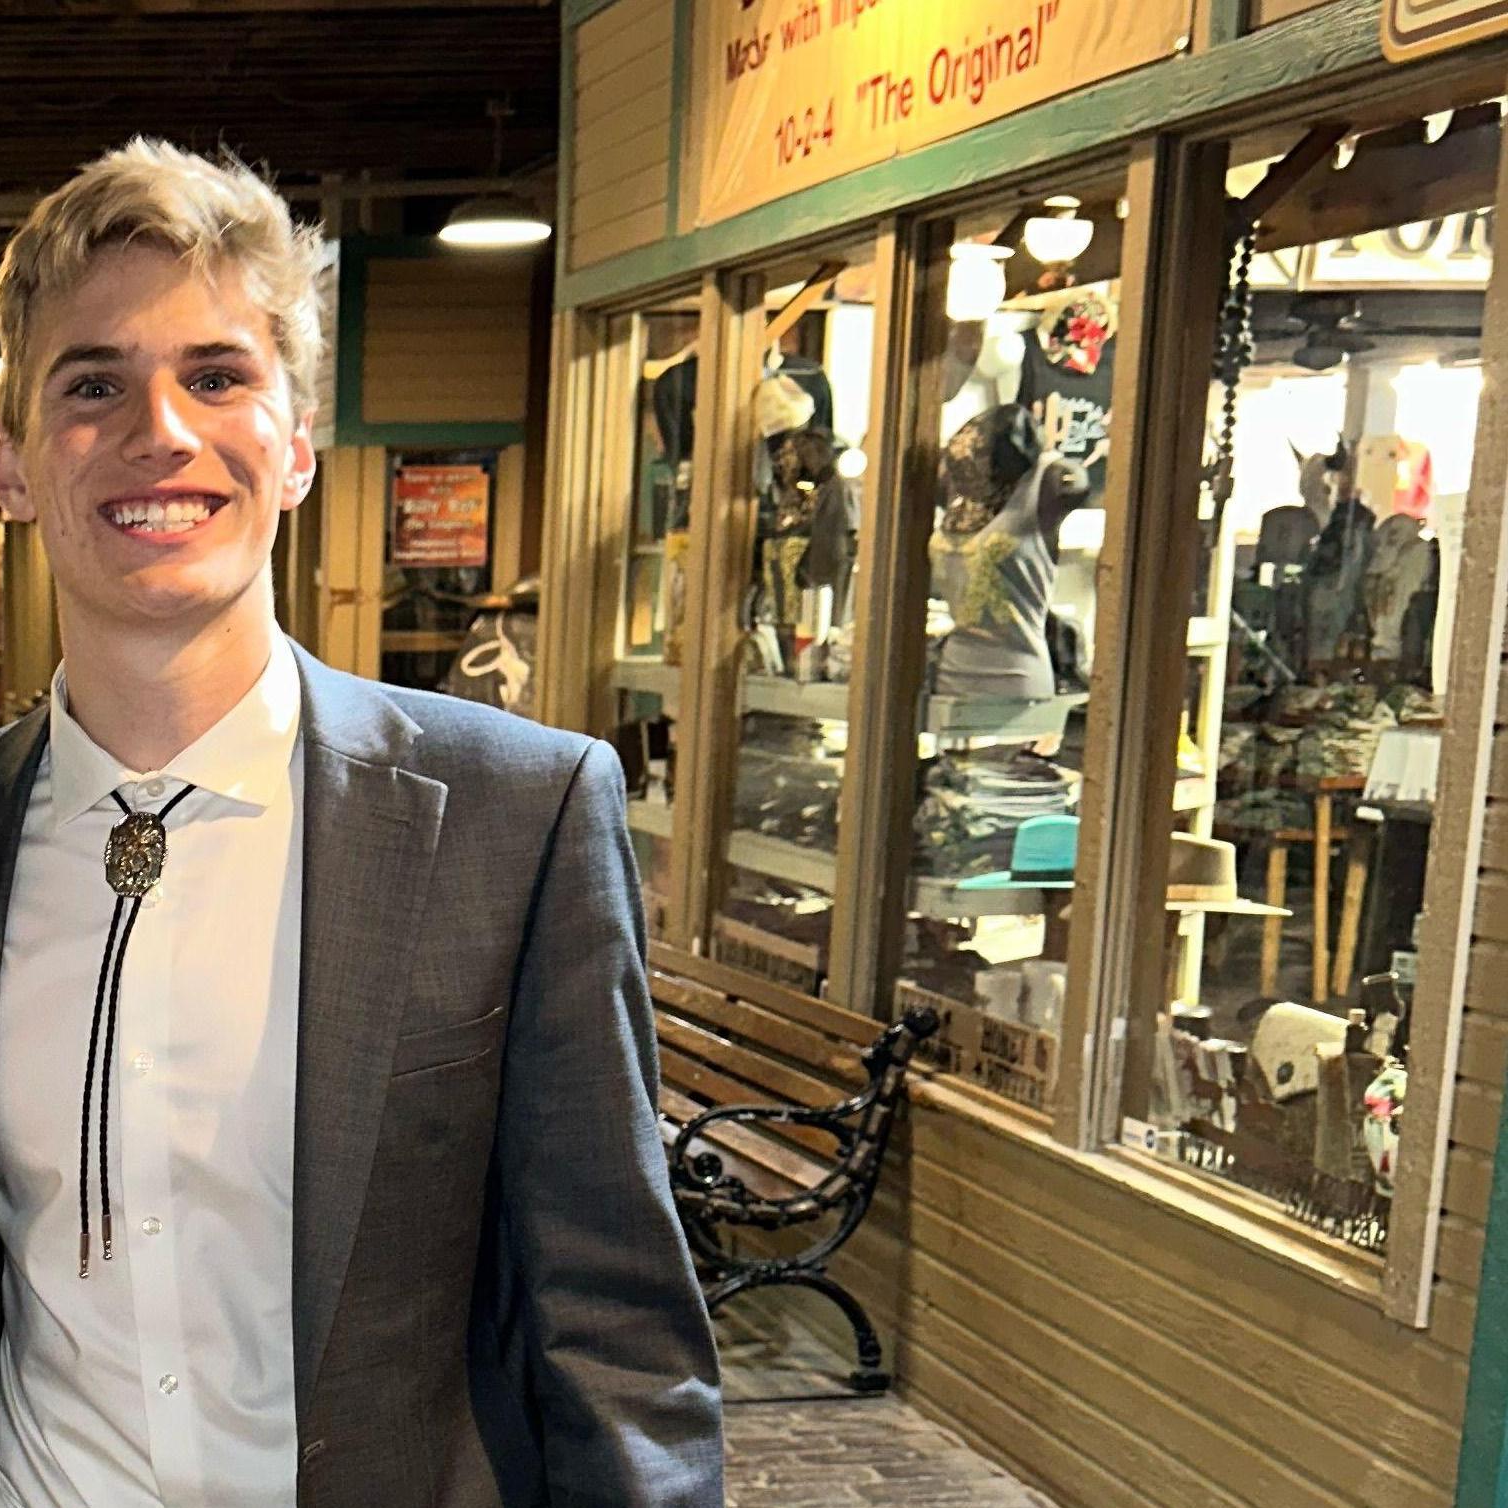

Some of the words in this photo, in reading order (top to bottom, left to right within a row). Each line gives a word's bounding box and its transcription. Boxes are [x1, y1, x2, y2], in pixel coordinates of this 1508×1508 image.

[780, 3, 822, 52] with
[775, 98, 835, 167] 10-2-4
[856, 70, 915, 131] "The
[928, 0, 1060, 106] Original"
